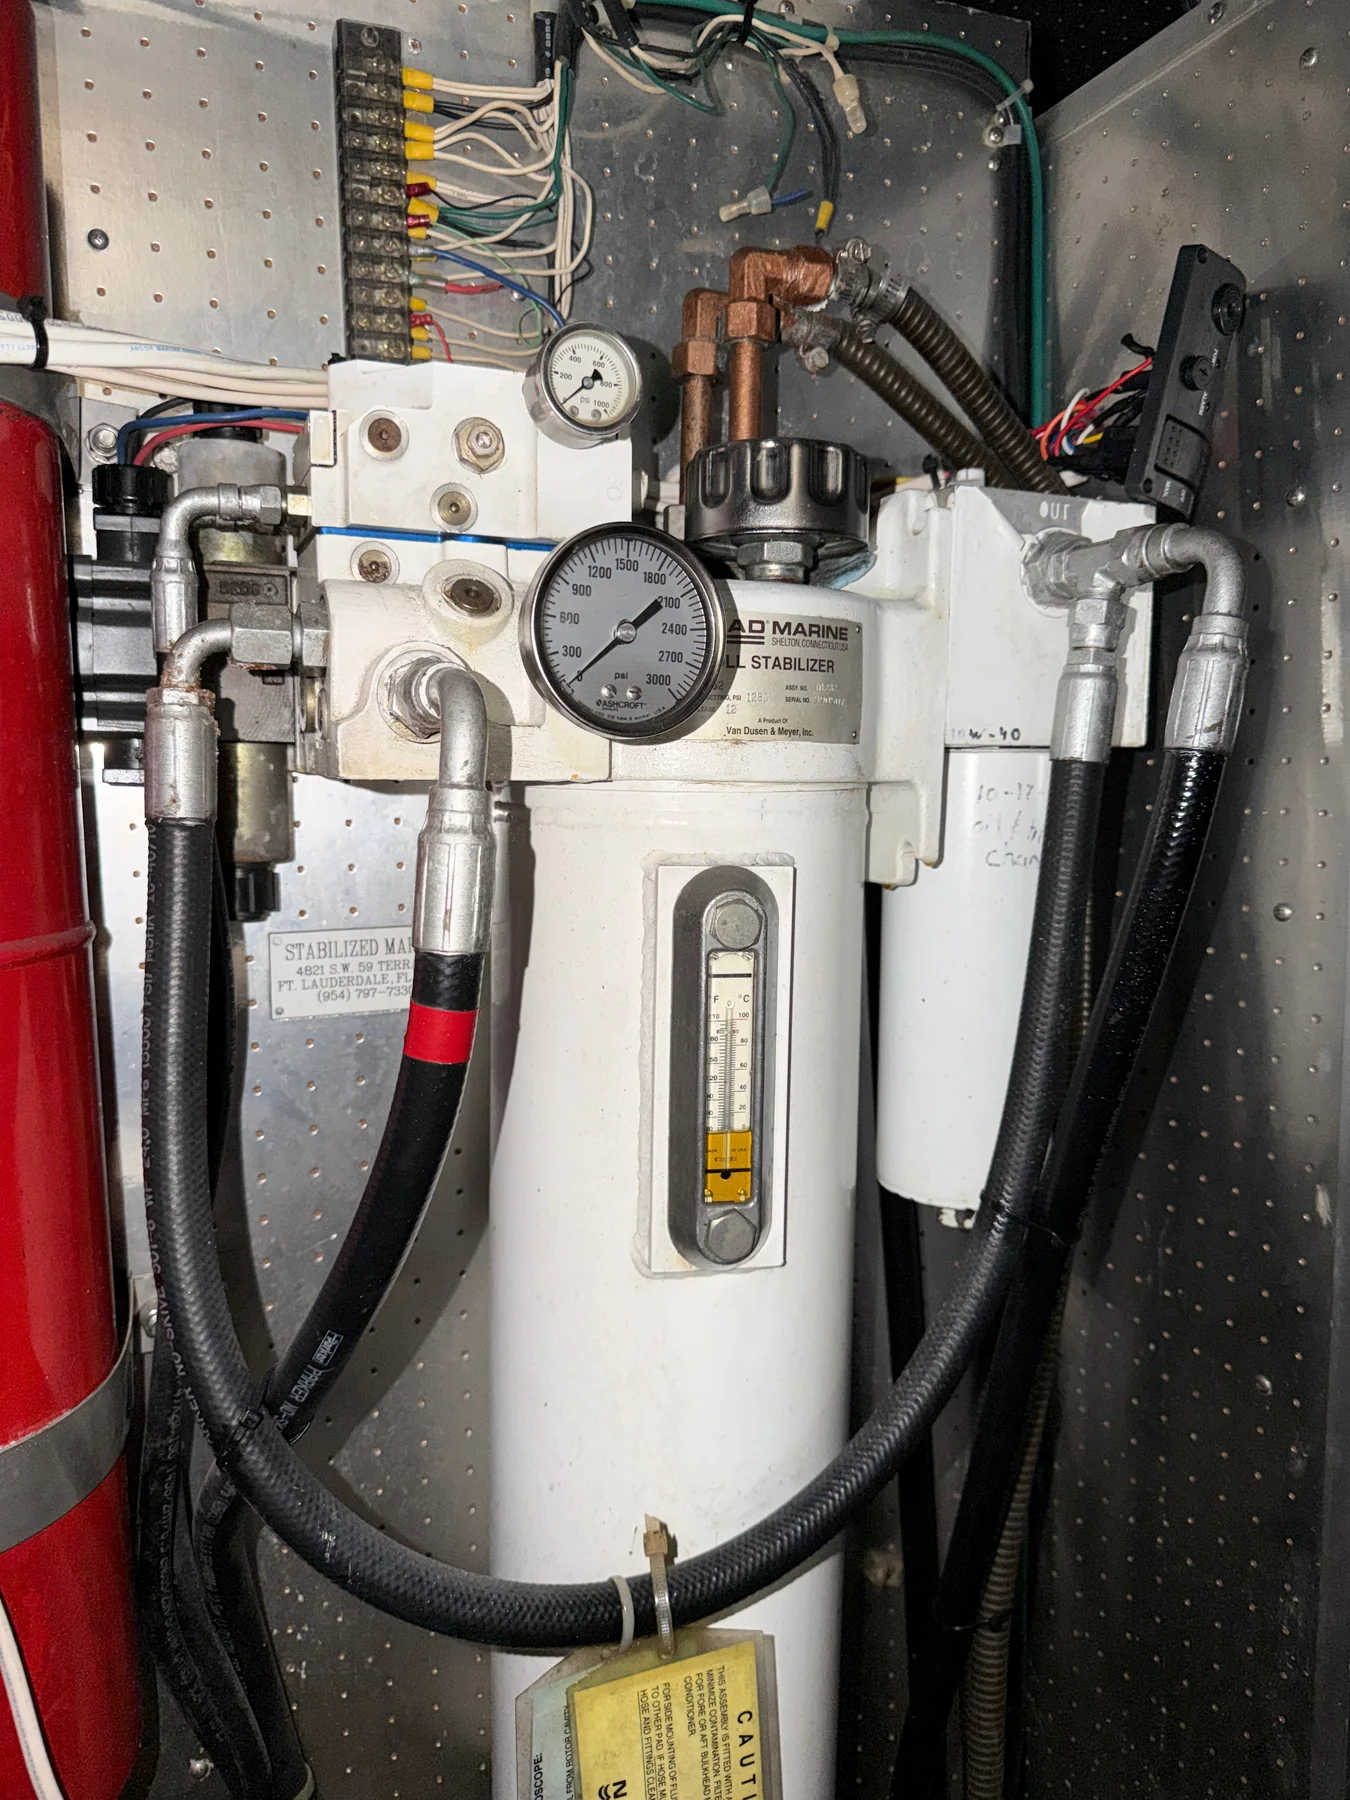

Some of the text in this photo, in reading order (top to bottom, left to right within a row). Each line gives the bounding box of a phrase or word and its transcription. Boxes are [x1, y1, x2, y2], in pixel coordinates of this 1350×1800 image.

[568, 355, 582, 363] 400
[592, 360, 605, 368] 600
[559, 372, 573, 380] 200
[599, 380, 613, 388] 800
[593, 400, 610, 409] 1000
[1040, 501, 1071, 520] OUT
[615, 557, 639, 572] 1500
[587, 565, 612, 579] 1200
[643, 571, 666, 585] 1800
[572, 583, 592, 597] 900
[658, 596, 681, 609] 2100
[559, 612, 580, 625] 600
[661, 622, 687, 636] 2400
[772, 620, 849, 641] MARINE
[562, 645, 582, 658] 300
[801, 639, 839, 651] CONNECTICUT
[839, 643, 849, 652] USA
[658, 650, 683, 663] 2700
[751, 655, 835, 673] STABILIZER
[614, 671, 629, 681] psi
[645, 673, 671, 686] 3000
[602, 700, 644, 710] ASHCROFT
[726, 704, 737, 715] 12
[726, 726, 814, 738] Van Dusen & Meyer, Inc.
[285, 939, 379, 962] STABILIZED
[296, 959, 414, 976] 4821 S.W. 59 TERR
[278, 980, 297, 992] FT.
[302, 976, 394, 990] LAUDERDALE,
[317, 990, 351, 1004] (954)
[289, 1364, 322, 1403] PARKER
[651, 1685, 660, 1699] TO
[662, 1682, 671, 1702] FOR
[706, 1669, 717, 1707] MINIMIZE
[640, 1689, 650, 1715] HOSE
[652, 1700, 662, 1733] OTHER
[663, 1702, 673, 1723] SIDE
[718, 1688, 729, 1731] ASSEMBLY
[642, 1716, 651, 1735] AND
[695, 1672, 711, 1797] FOR FORE OR AFT BULKHEAD
[721, 1732, 730, 1742] IS
[564, 1737, 574, 1768] ROTOR
[665, 1723, 676, 1770] MOUNTING
[644, 1736, 654, 1776] FITTINGS
[722, 1743, 731, 1772] FITTED
[565, 1770, 574, 1794] FROM
[657, 1763, 666, 1788] HOSE
[668, 1770, 677, 1782] OF
[724, 1773, 732, 1795] WITH
